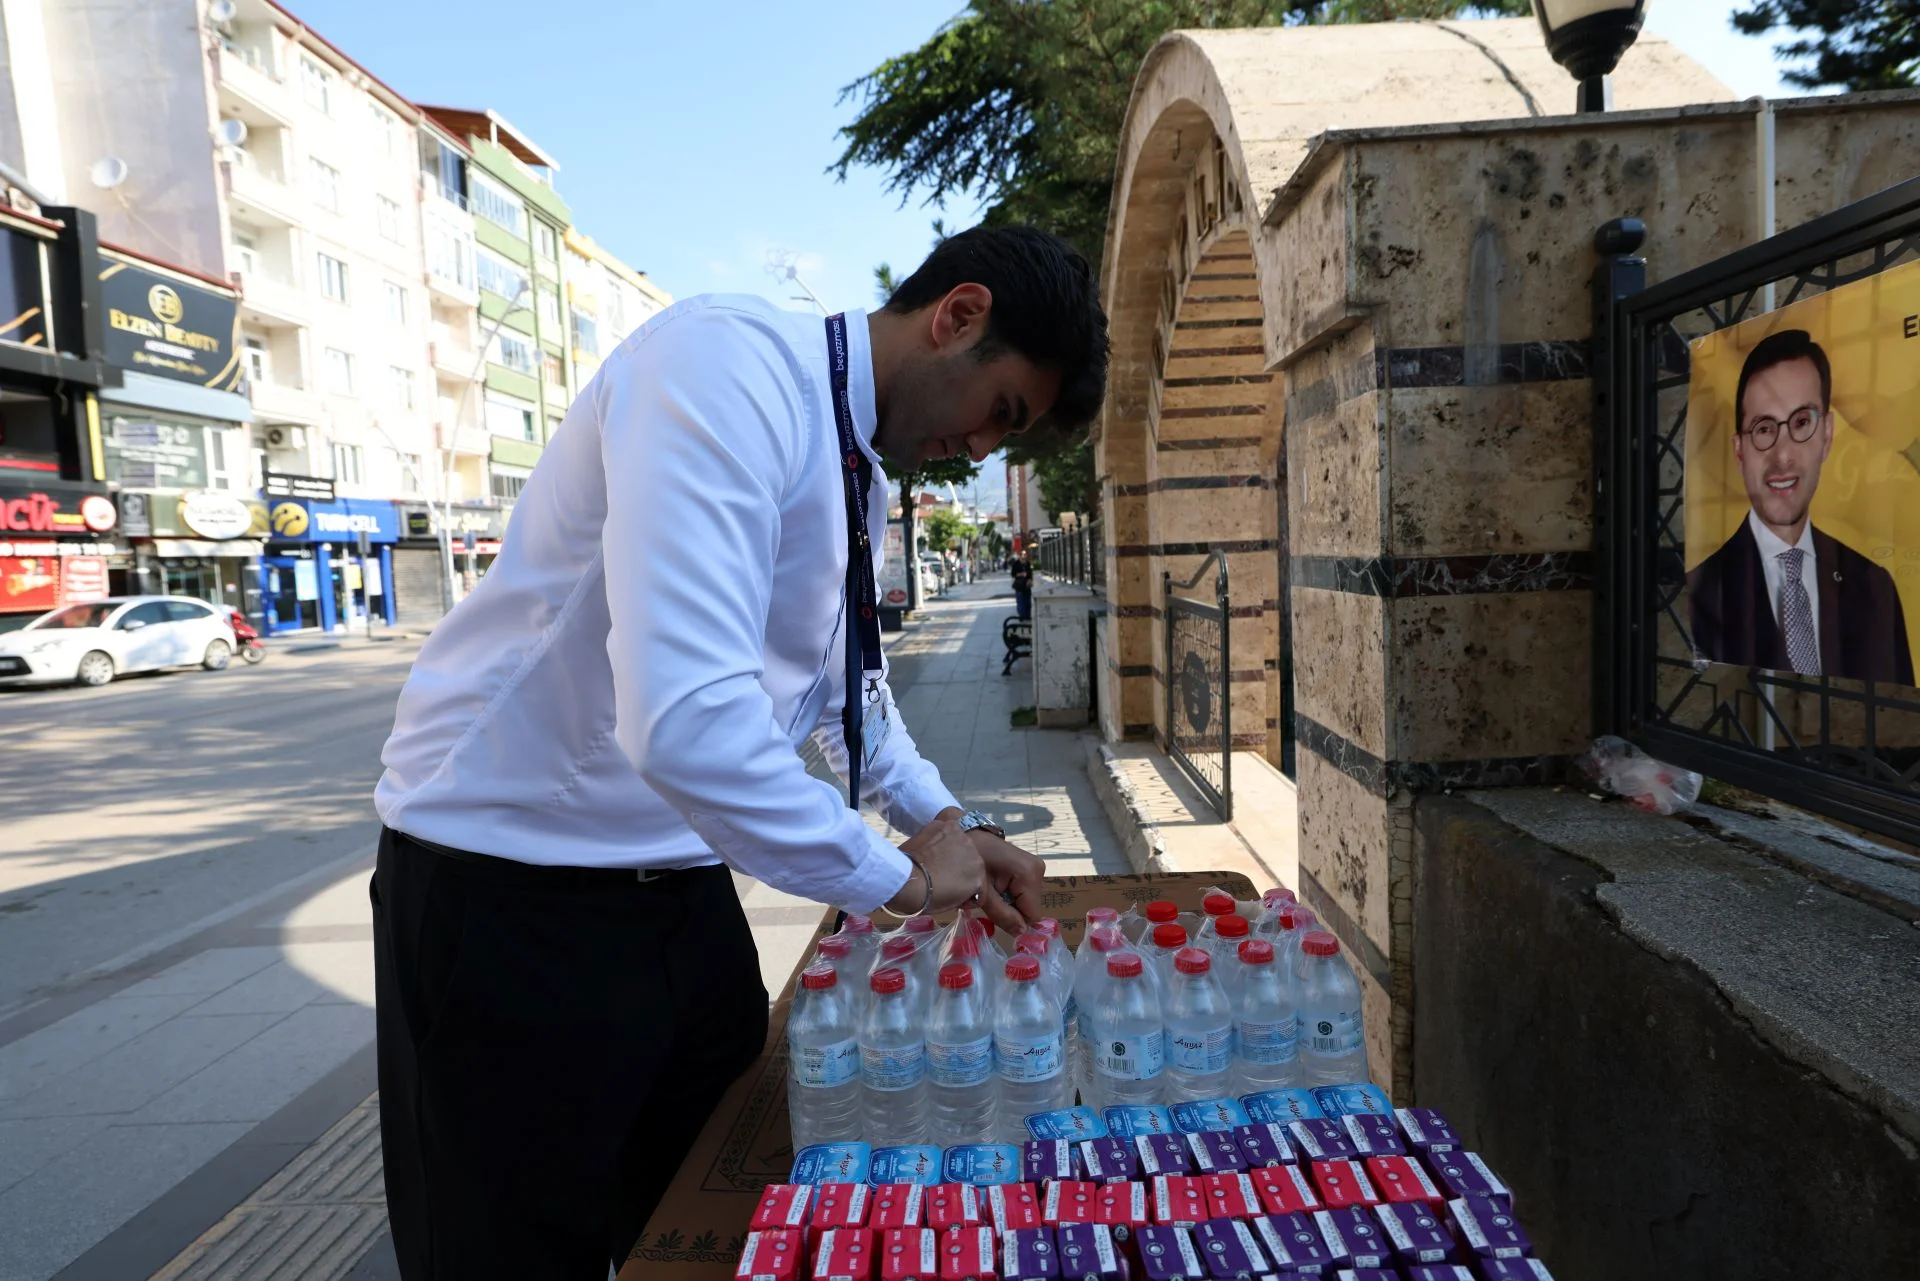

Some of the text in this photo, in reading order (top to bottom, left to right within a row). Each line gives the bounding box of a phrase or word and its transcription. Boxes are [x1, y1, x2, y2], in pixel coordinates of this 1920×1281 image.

[1903, 314, 1920, 339] E
[833, 320, 845, 372] beyazmasa
[840, 390, 854, 451] beyazmasa
[314, 512, 381, 533] TURKCELL
